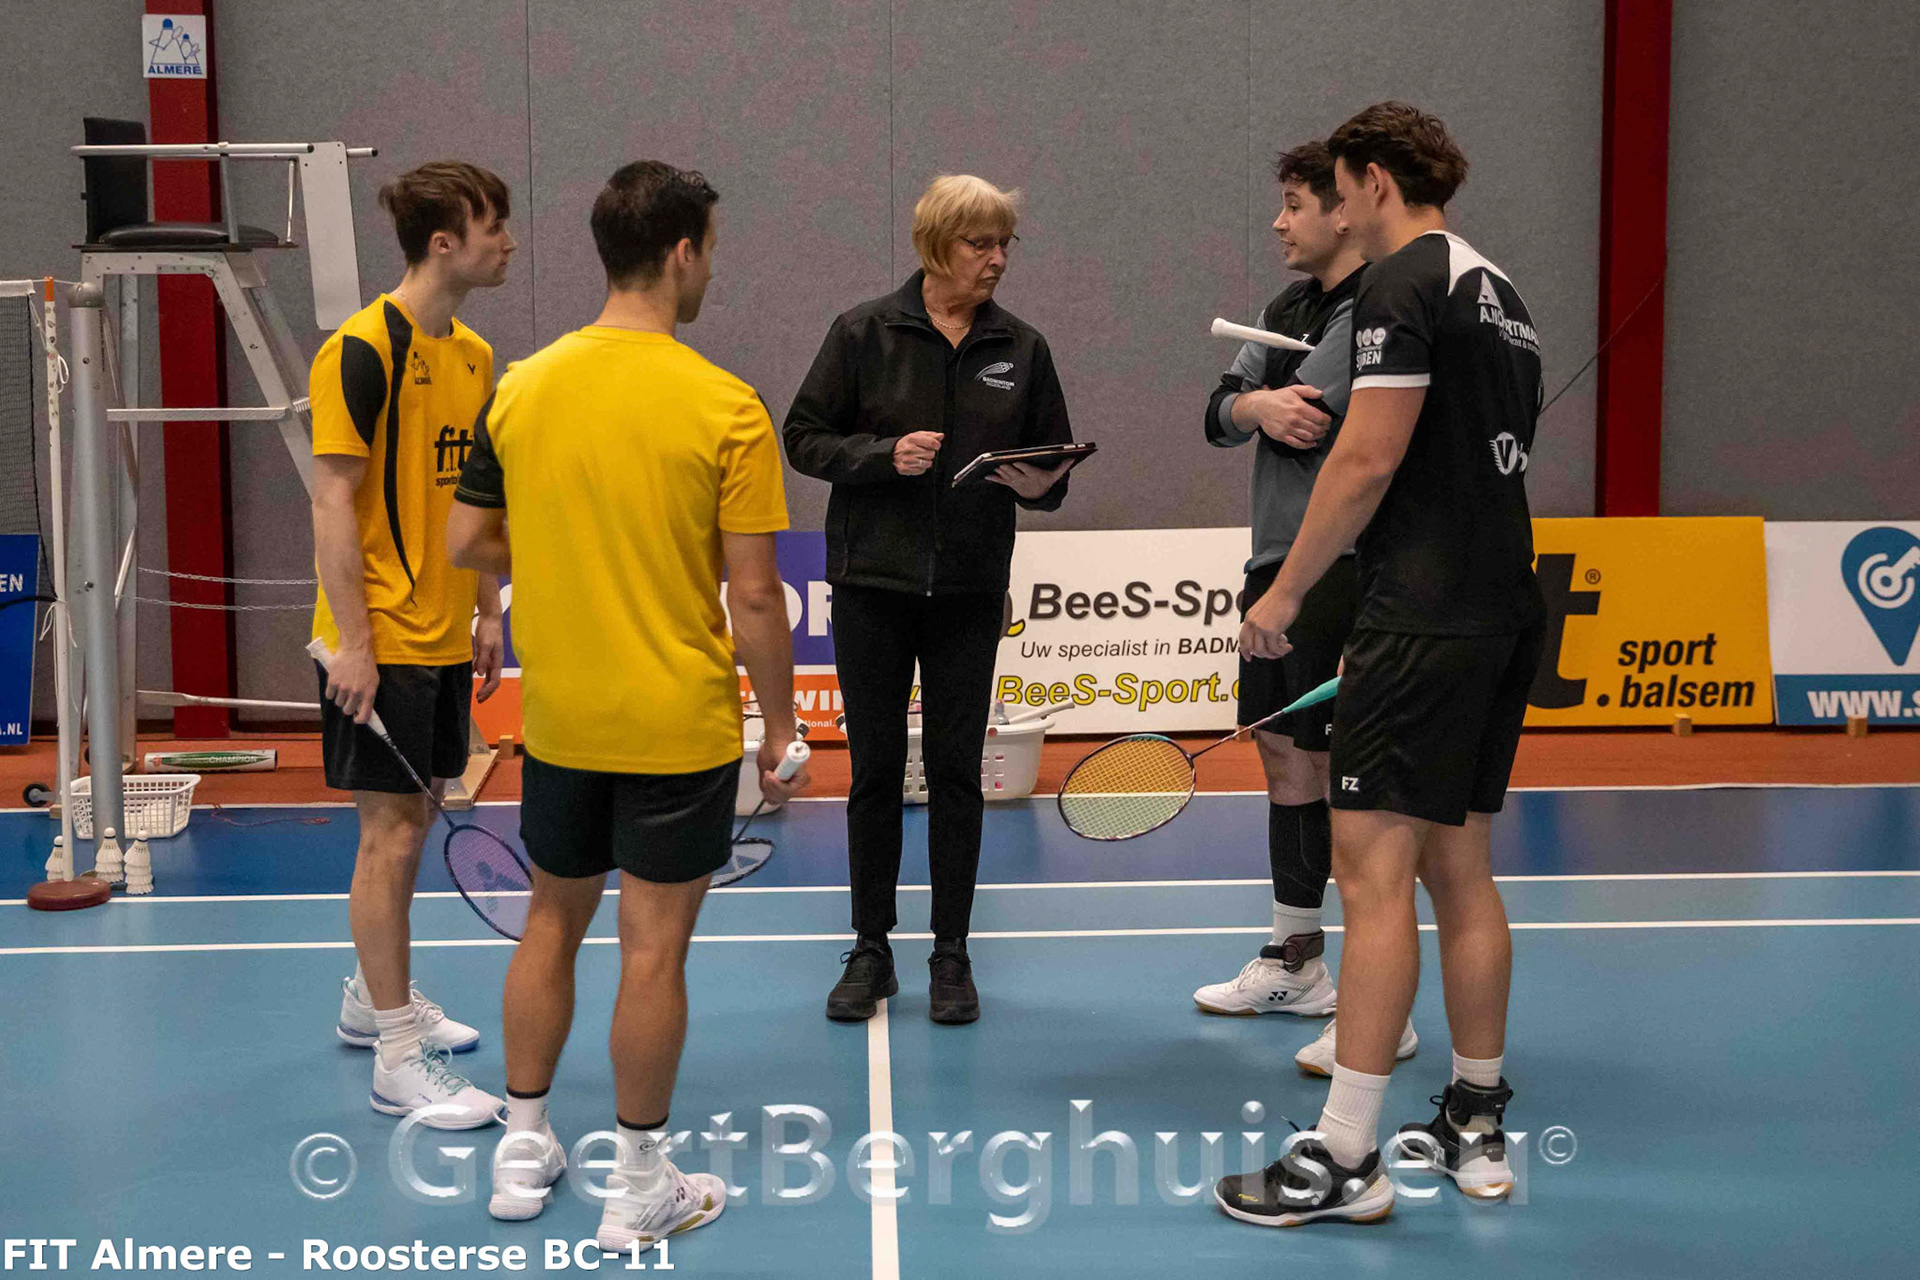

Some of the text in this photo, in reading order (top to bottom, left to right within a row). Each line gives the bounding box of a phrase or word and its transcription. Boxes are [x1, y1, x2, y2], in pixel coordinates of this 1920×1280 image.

[148, 65, 203, 75] ALMERE
[1021, 641, 1053, 659] Uw
[1058, 639, 1148, 662] specialist
[1154, 639, 1171, 656] in
[1618, 633, 1717, 674] sport
[0, 723, 23, 735] .NL
[209, 755, 257, 764] CHAMPION
[1341, 775, 1360, 791] FZ
